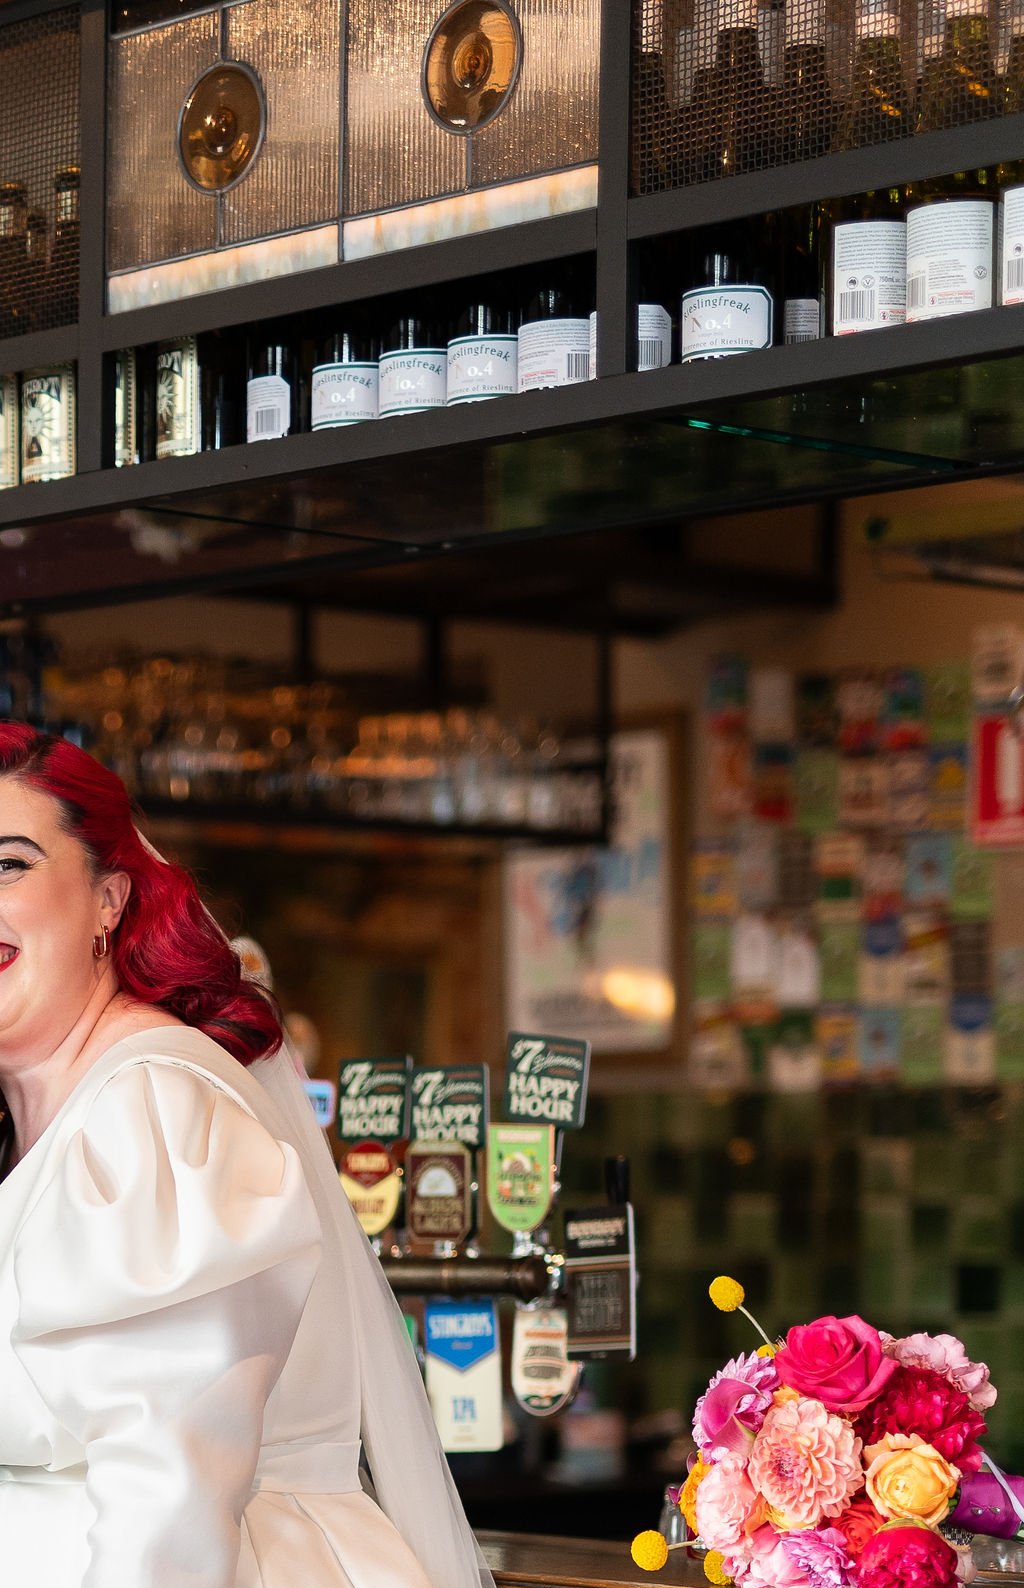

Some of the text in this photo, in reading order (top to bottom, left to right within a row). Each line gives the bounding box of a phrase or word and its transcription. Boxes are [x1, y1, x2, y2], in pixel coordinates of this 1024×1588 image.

[721, 337, 754, 346] Riesling
[509, 1071, 580, 1102] HAPPY
[340, 1094, 404, 1116] HAPPY
[413, 1104, 482, 1127] HAPPY
[510, 1094, 574, 1122] HOUR
[342, 1114, 400, 1137] HOUR
[416, 1124, 479, 1145] HOUR
